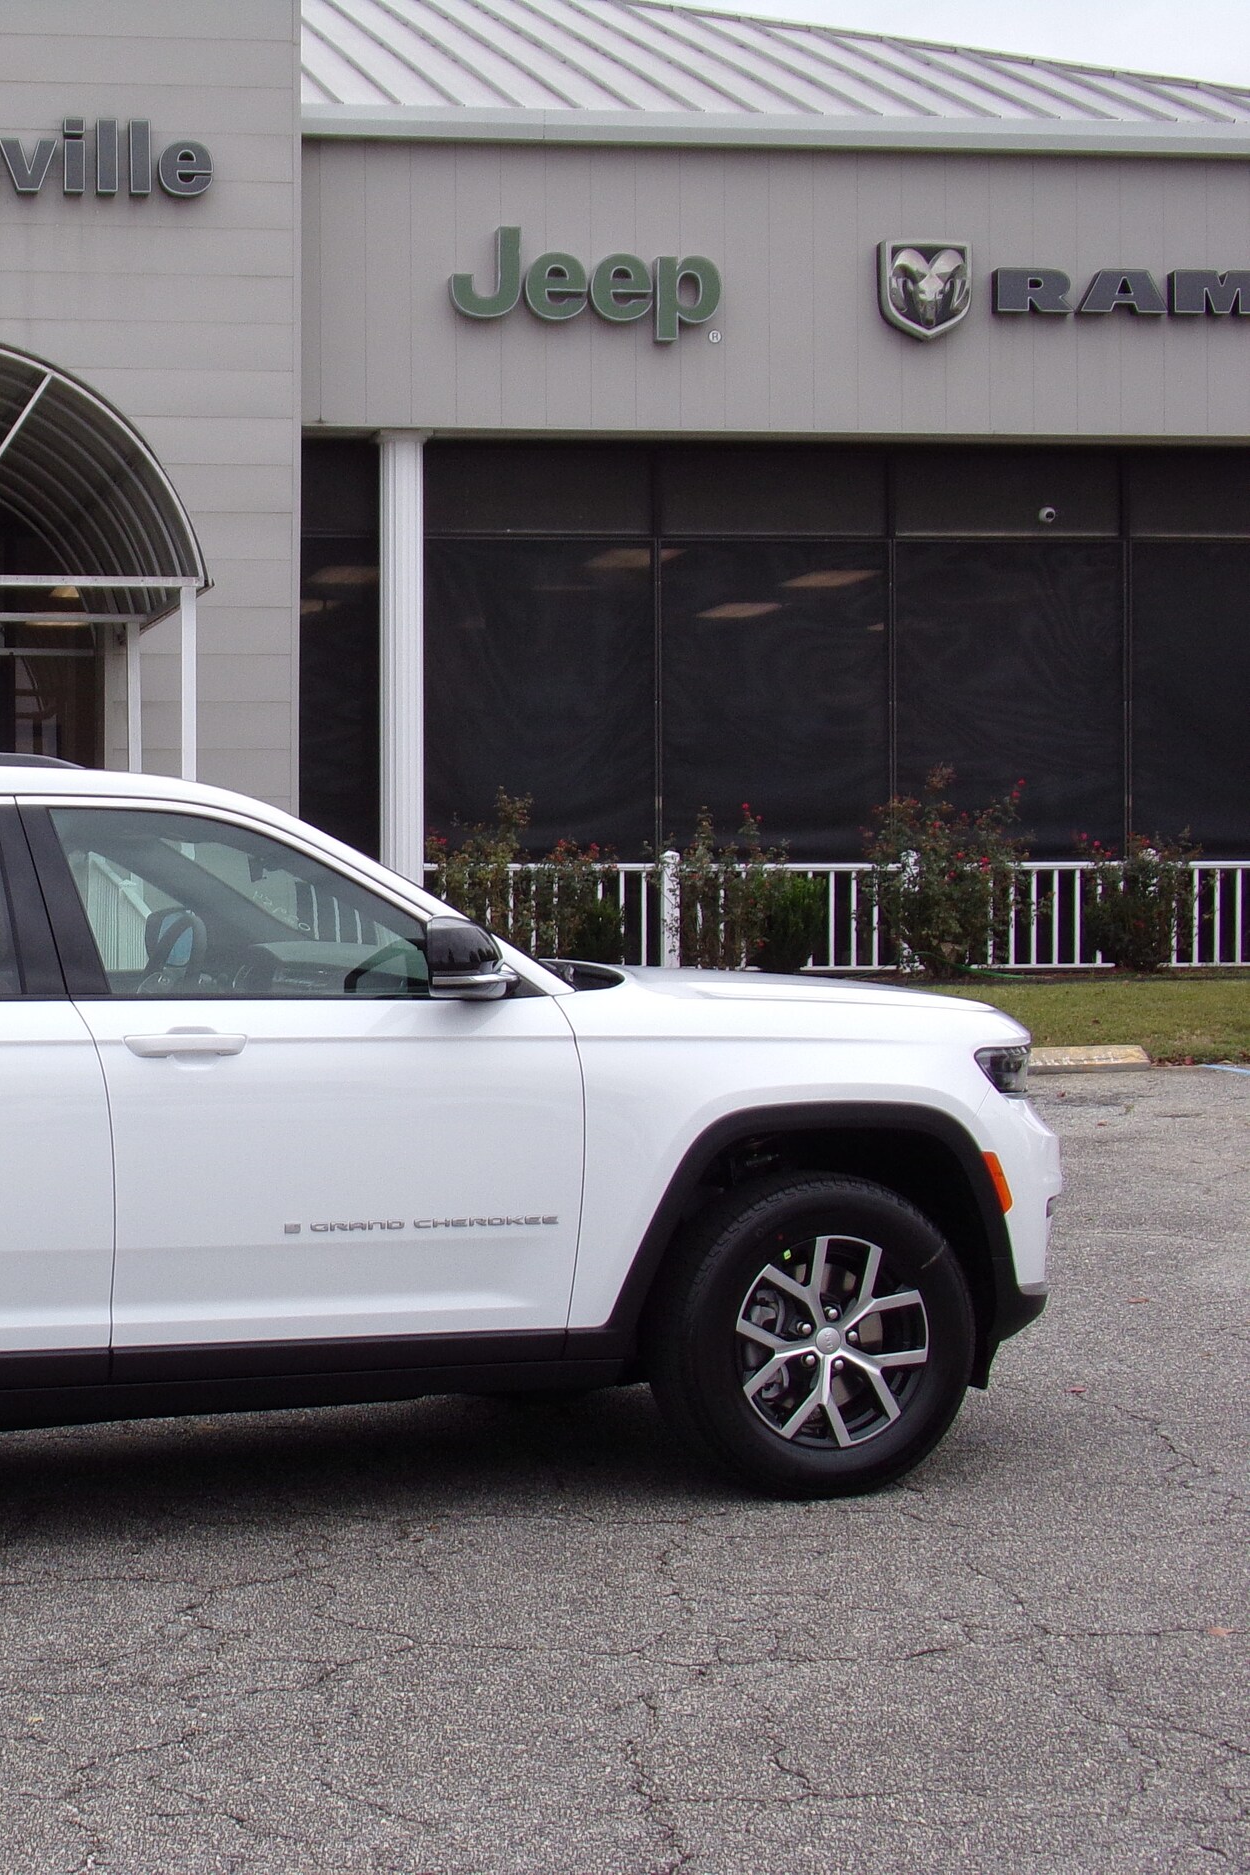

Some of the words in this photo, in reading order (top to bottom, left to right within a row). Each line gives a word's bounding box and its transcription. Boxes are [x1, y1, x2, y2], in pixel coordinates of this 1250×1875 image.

[448, 225, 723, 343] Jeep
[991, 267, 1250, 316] RAM
[310, 1218, 405, 1232] GRAND
[413, 1214, 559, 1229] CHEROKEE
